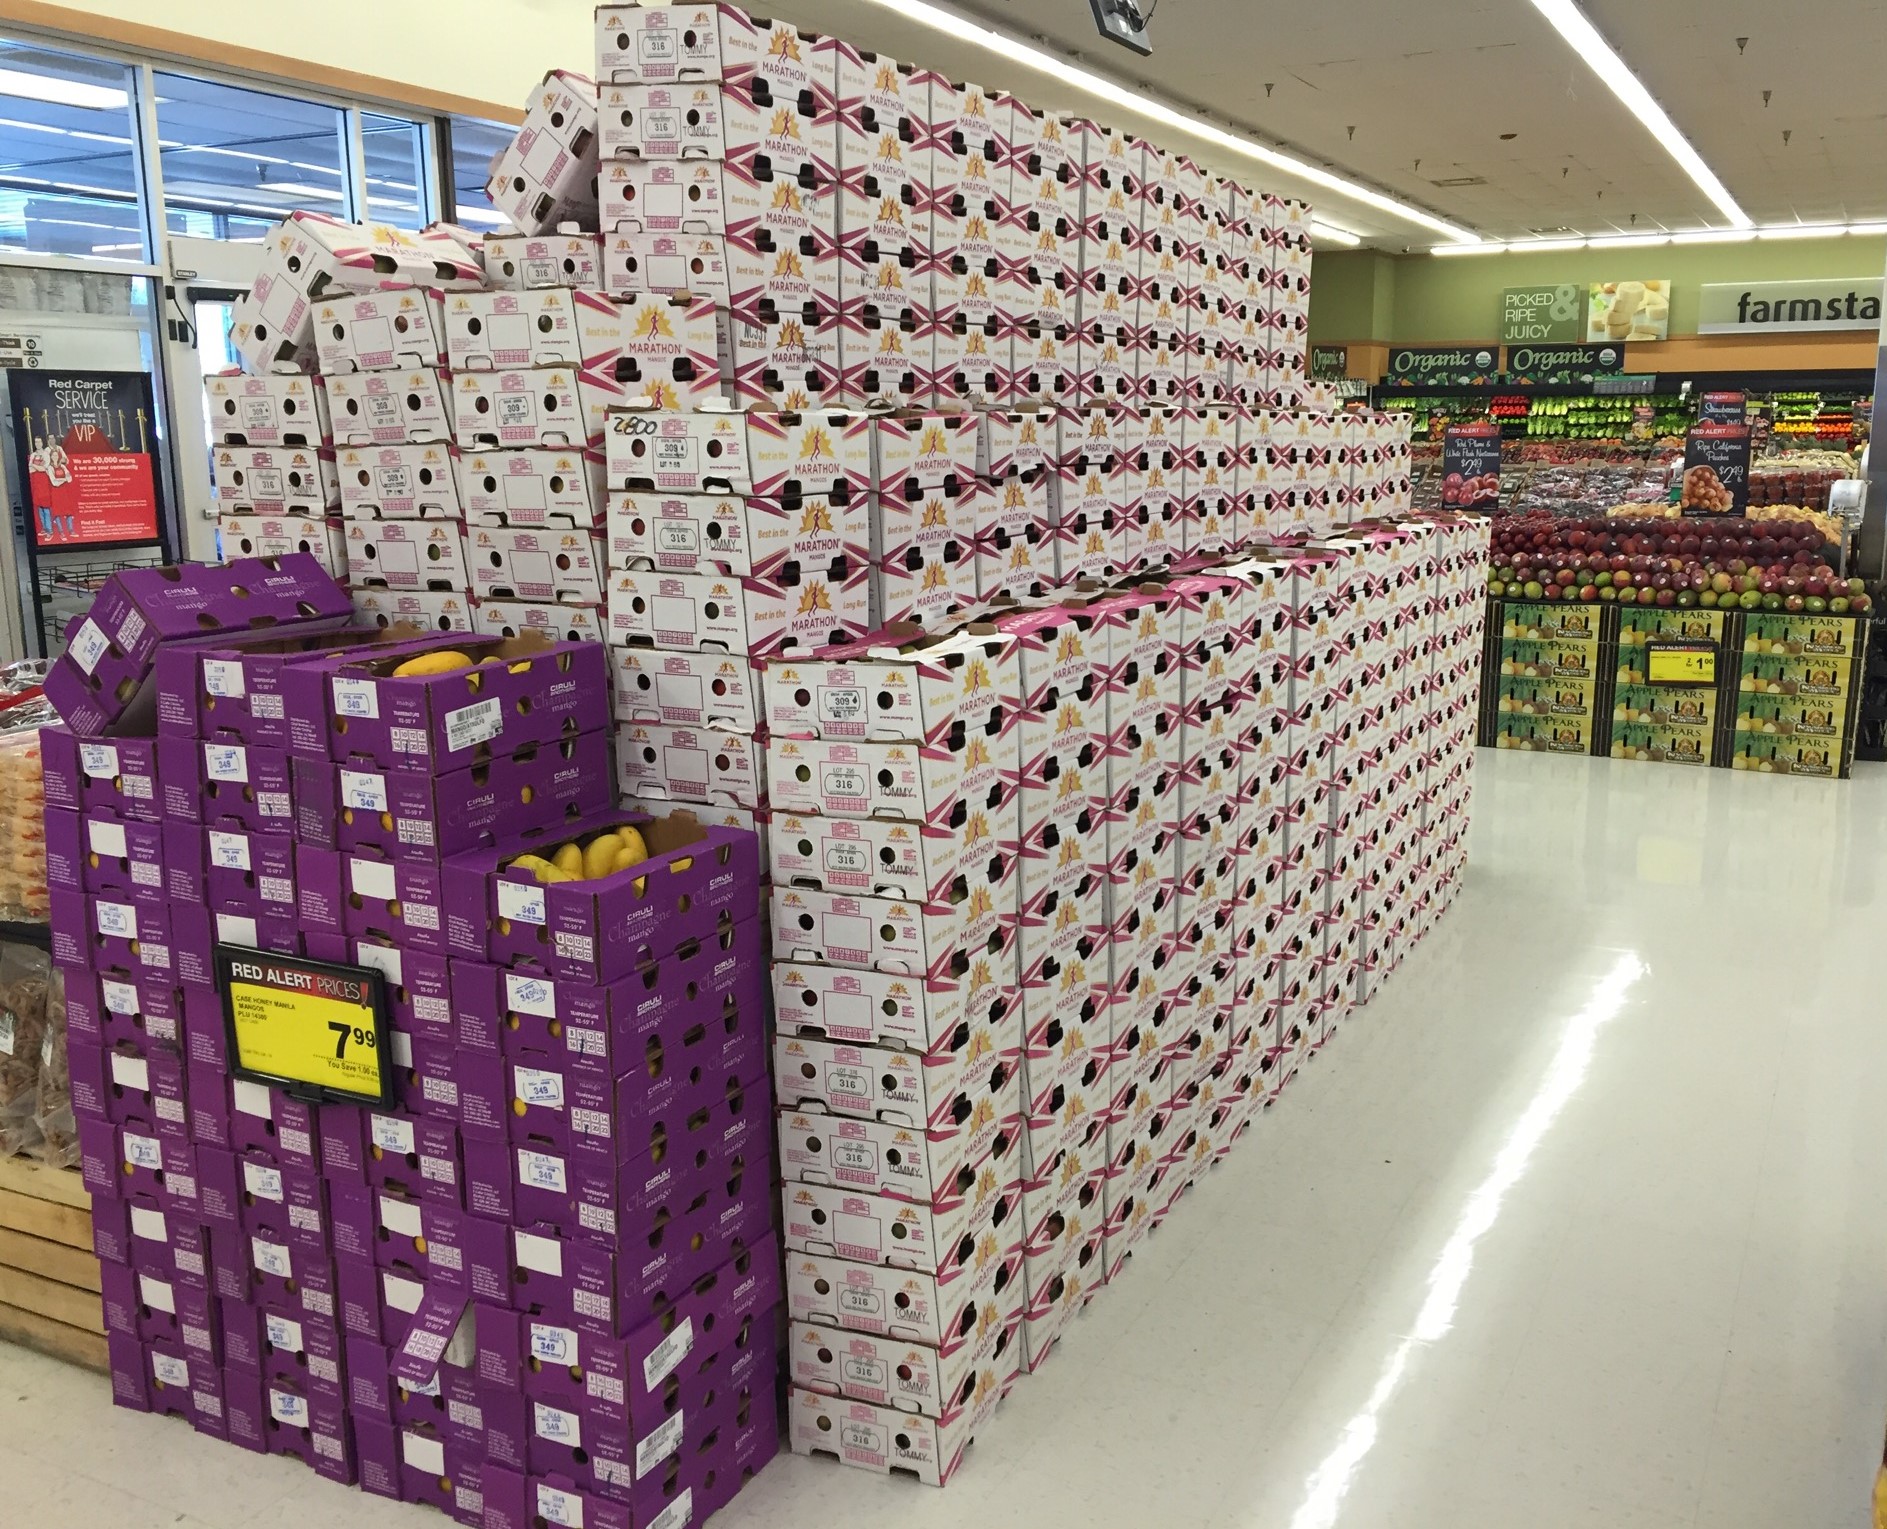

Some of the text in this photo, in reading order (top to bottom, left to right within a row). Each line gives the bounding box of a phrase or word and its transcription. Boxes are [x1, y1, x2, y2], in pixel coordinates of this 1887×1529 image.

[651, 41, 666, 51] 316
[680, 44, 708, 56] TOMMY
[728, 36, 742, 46] Best
[748, 41, 758, 51] the
[762, 61, 807, 83] MARATHON
[870, 94, 904, 113] MARATHON
[960, 116, 991, 134] MARATHON
[765, 139, 808, 157] MARATHON
[872, 162, 907, 178] MARATHON
[766, 212, 809, 229] MARATHON
[536, 269, 549, 278] 316
[562, 271, 589, 282] TOMMY
[769, 280, 811, 294] MARATHON
[1506, 293, 1554, 307] PICKED
[1549, 285, 1580, 321] &
[1737, 292, 1880, 323] farmsta
[1505, 309, 1537, 322] RIPE
[1505, 324, 1552, 339] JUICY
[629, 342, 682, 355] MARATHON
[874, 356, 909, 368] MARATHON
[1314, 349, 1340, 371] Organic
[1395, 351, 1472, 373] Organic
[1514, 348, 1595, 371] Organic
[49, 379, 113, 390] Red Carpet
[55, 391, 109, 409] SERVICE
[75, 424, 96, 442] VIP
[613, 415, 658, 436] 2800
[1695, 440, 1742, 452] Ripe California
[795, 463, 841, 475] MARATHON
[914, 459, 951, 471] MARATHON
[262, 481, 274, 490] 316
[1000, 512, 1030, 525] MARATHON
[757, 528, 789, 540] Best in the
[916, 529, 952, 544] MARATHON
[795, 538, 841, 554] MARATHON
[1005, 570, 1036, 586] MARATHON
[164, 587, 196, 596] CIRULI
[917, 592, 952, 608] MARATHON
[754, 610, 786, 621] Best in the
[1799, 616, 1842, 628] PEARS
[791, 615, 838, 632] MARATHON
[1548, 641, 1587, 652] PEARS
[1794, 656, 1838, 668] PEARS
[1053, 661, 1089, 681] MARATHON
[549, 679, 576, 694] CIRULI
[1545, 678, 1584, 690] PEARS
[1664, 686, 1704, 699] PEARS
[835, 696, 850, 707] 309
[958, 694, 997, 714] MARATHON
[1543, 715, 1582, 728] PEARS
[1660, 724, 1702, 737] PEARS
[1051, 732, 1088, 751] MARATHON
[1786, 734, 1829, 749] PEARS
[960, 767, 997, 792] MARATHON
[467, 792, 495, 807] CIRULI
[959, 842, 995, 867] MARATHON
[880, 863, 914, 875] TOMMY
[521, 905, 537, 916] 349
[627, 904, 654, 921] CIRULI
[714, 954, 737, 973] CIRULI
[231, 961, 263, 981] RED
[266, 968, 313, 990] ALERT
[238, 1002, 265, 1012] MANGOS
[273, 1000, 296, 1010] MANILA
[723, 1034, 745, 1051] CIRULI
[327, 1060, 340, 1069] You
[341, 1062, 357, 1073] Save
[839, 1079, 856, 1089] 316
[724, 1118, 747, 1137] CIRULI
[642, 1252, 667, 1272] CIRULI
[851, 1296, 869, 1307] 316
[894, 1308, 928, 1322] TOMMY
[540, 1342, 556, 1352] 349
[894, 1447, 927, 1462] TOMMY
